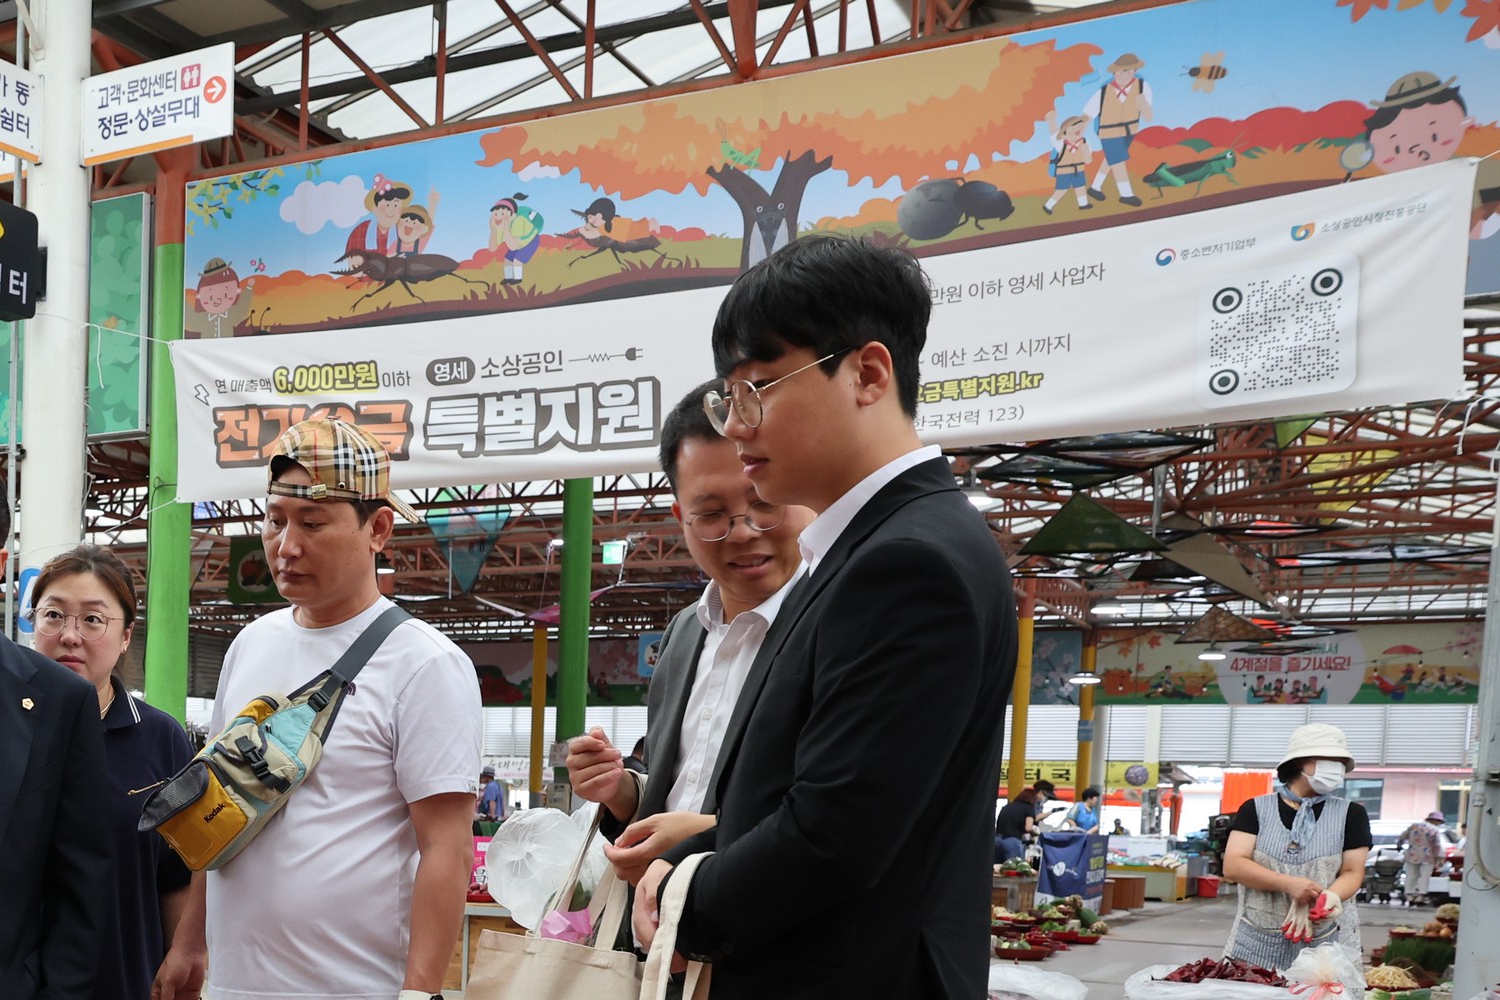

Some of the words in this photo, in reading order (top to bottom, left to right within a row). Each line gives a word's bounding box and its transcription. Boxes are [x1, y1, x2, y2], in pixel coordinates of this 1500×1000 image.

[1321, 202, 1427, 234] 소상공인시장진흥공단
[969, 278, 1003, 300] 이하
[1008, 272, 1044, 295] 영세
[1049, 262, 1106, 288] 사업자
[433, 360, 468, 382] 영세
[481, 350, 563, 379] 소상공인
[931, 347, 967, 368] 예산
[973, 342, 1008, 363] 소진
[1015, 333, 1072, 357] 시까지
[215, 379, 228, 394] 연
[231, 378, 272, 393] 매출액
[273, 360, 380, 394] 6,000만원
[382, 370, 411, 388] 이하
[424, 376, 661, 458] 특별지원
[988, 405, 1025, 423] 123)
[1230, 656, 1282, 672] 4계절을
[1287, 656, 1351, 671] 즐기세요!
[203, 803, 226, 824] Kodak
